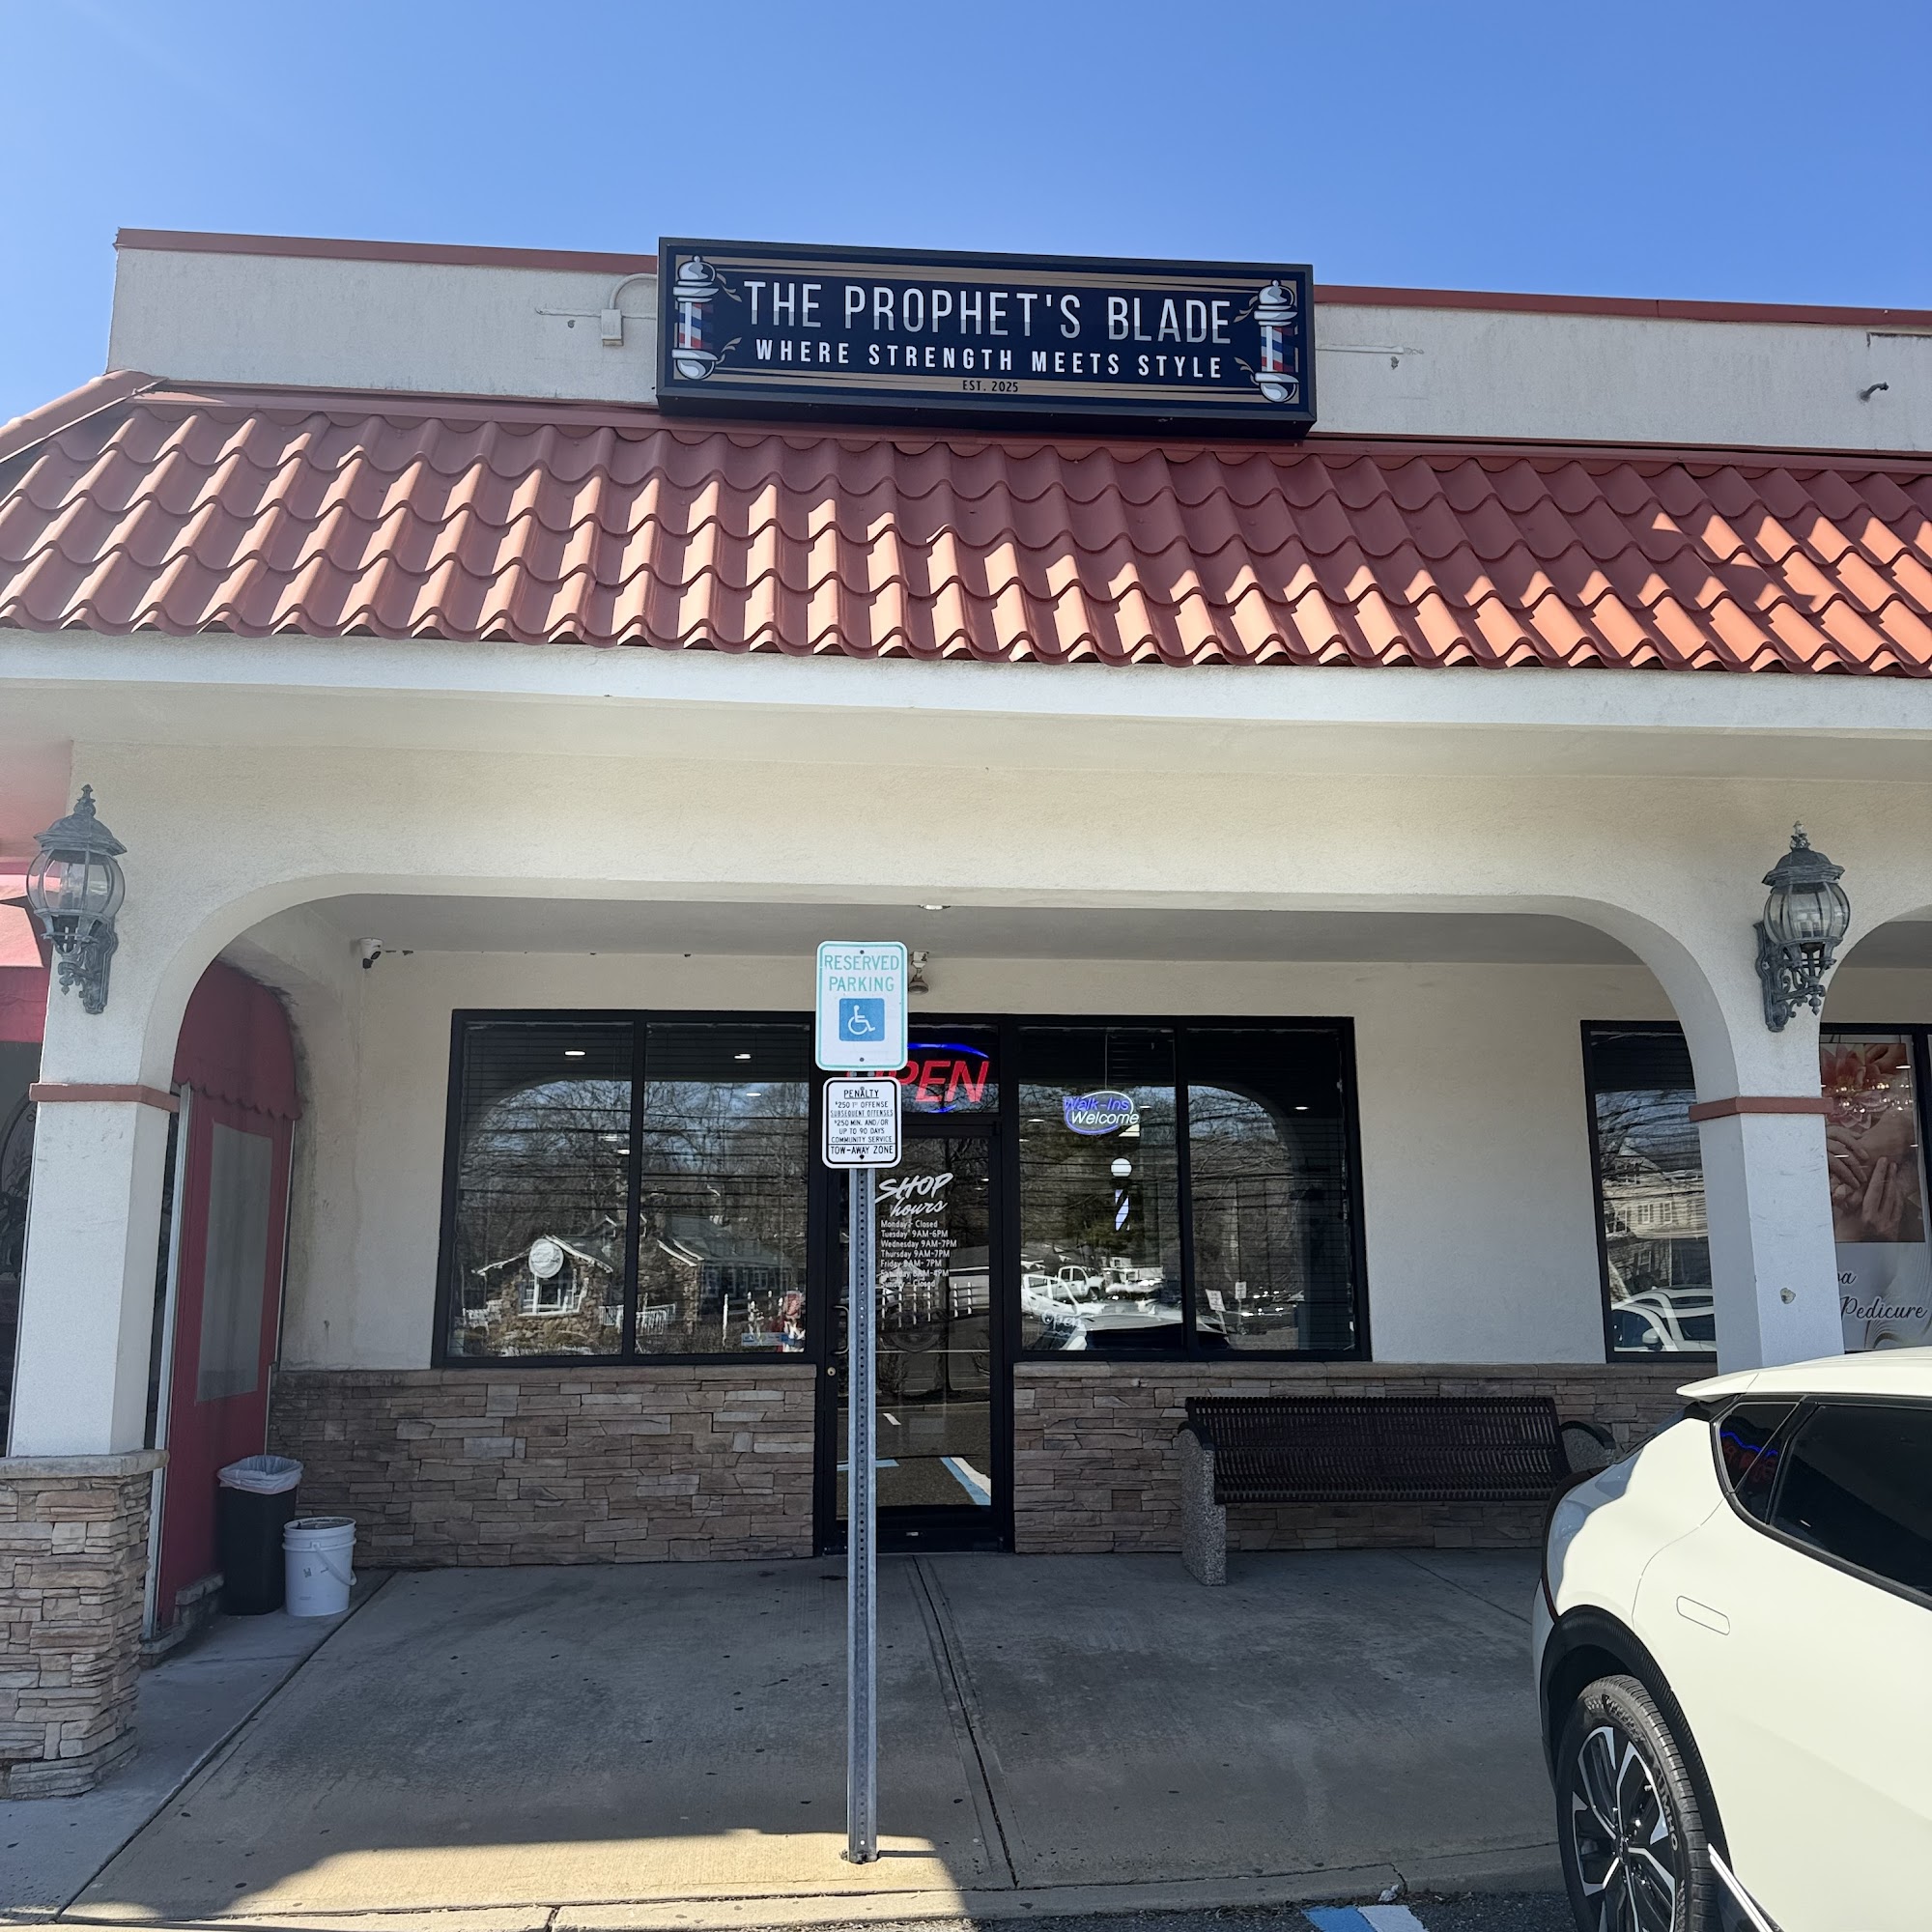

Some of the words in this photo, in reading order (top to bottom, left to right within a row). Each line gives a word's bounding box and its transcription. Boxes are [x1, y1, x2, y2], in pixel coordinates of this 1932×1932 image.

[744, 280, 821, 328] THE
[844, 285, 1081, 339] PROPHET'S
[1107, 297, 1231, 344] BLADE
[755, 338, 850, 364] WHERE
[868, 343, 1012, 371] STRENGTH
[1031, 351, 1120, 375] MEETS
[1137, 355, 1222, 379] STYLE
[962, 380, 986, 391] EST.
[991, 381, 1019, 393] 2025
[824, 954, 900, 971] RESERVED
[829, 976, 895, 992] PARKING
[845, 1060, 989, 1103] PEN
[843, 1089, 880, 1099] PENALTY
[860, 1100, 889, 1109] OFFENSE
[830, 1109, 866, 1118] SUBSEQUENT
[867, 1109, 894, 1118] OFFENSES
[1071, 1110, 1140, 1125] Welcome
[867, 1135, 893, 1144] SERVICE
[831, 1146, 870, 1155] TOW-AWAY
[872, 1145, 894, 1154] ZONE
[875, 1172, 953, 1205] SHOP
[890, 1197, 949, 1217] hours
[880, 1219, 908, 1230] Monday
[915, 1219, 938, 1229] Closed
[880, 1229, 907, 1239] Tuesday
[911, 1229, 949, 1238] 9AM-6PM
[880, 1239, 919, 1249] Wednesday
[921, 1238, 957, 1248] 9AM-7PM
[880, 1249, 912, 1260] Thursday
[914, 1249, 951, 1258] 9AM-7PM
[880, 1259, 903, 1268] Friday
[925, 1259, 942, 1267] 7PM
[913, 1278, 936, 1288] Closed
[1840, 1295, 1928, 1321] Pedicure
